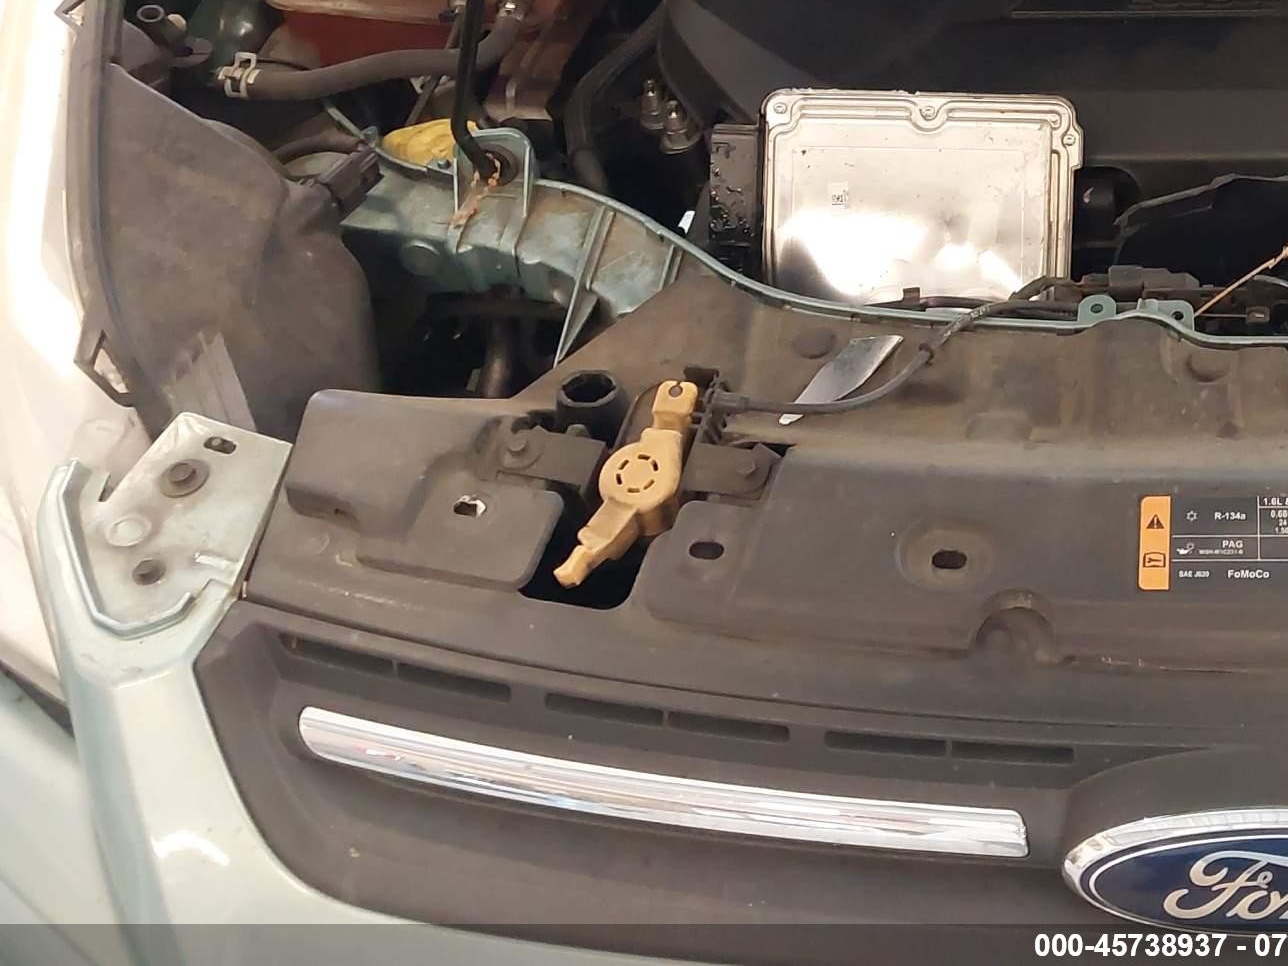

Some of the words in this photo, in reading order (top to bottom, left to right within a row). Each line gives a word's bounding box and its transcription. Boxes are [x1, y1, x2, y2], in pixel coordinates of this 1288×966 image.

[1214, 512, 1246, 520] R-134a
[1222, 540, 1243, 548] PAG
[1227, 569, 1270, 579] FoMoCo
